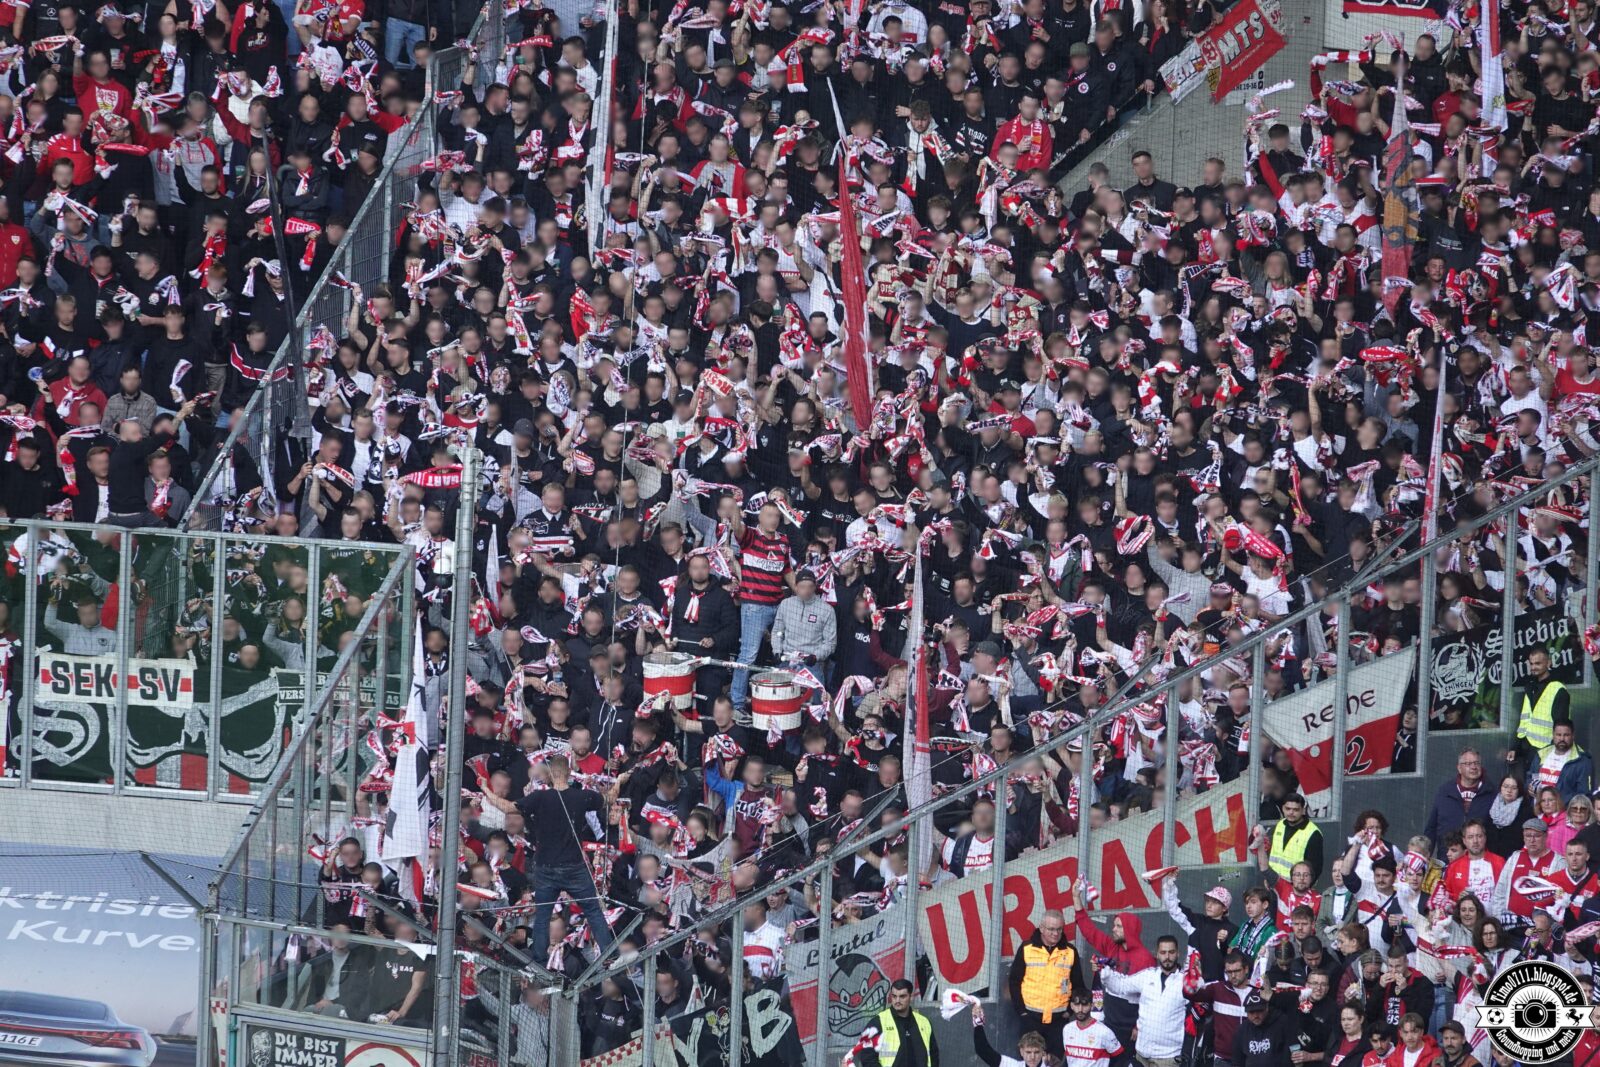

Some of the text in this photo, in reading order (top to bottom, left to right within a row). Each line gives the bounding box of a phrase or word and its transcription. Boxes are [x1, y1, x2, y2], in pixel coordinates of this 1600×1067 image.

[1217, 10, 1265, 65] MTS
[51, 660, 181, 702] SEK SV
[274, 1031, 340, 1055] DU BIST
[274, 1047, 338, 1067] IMMER
